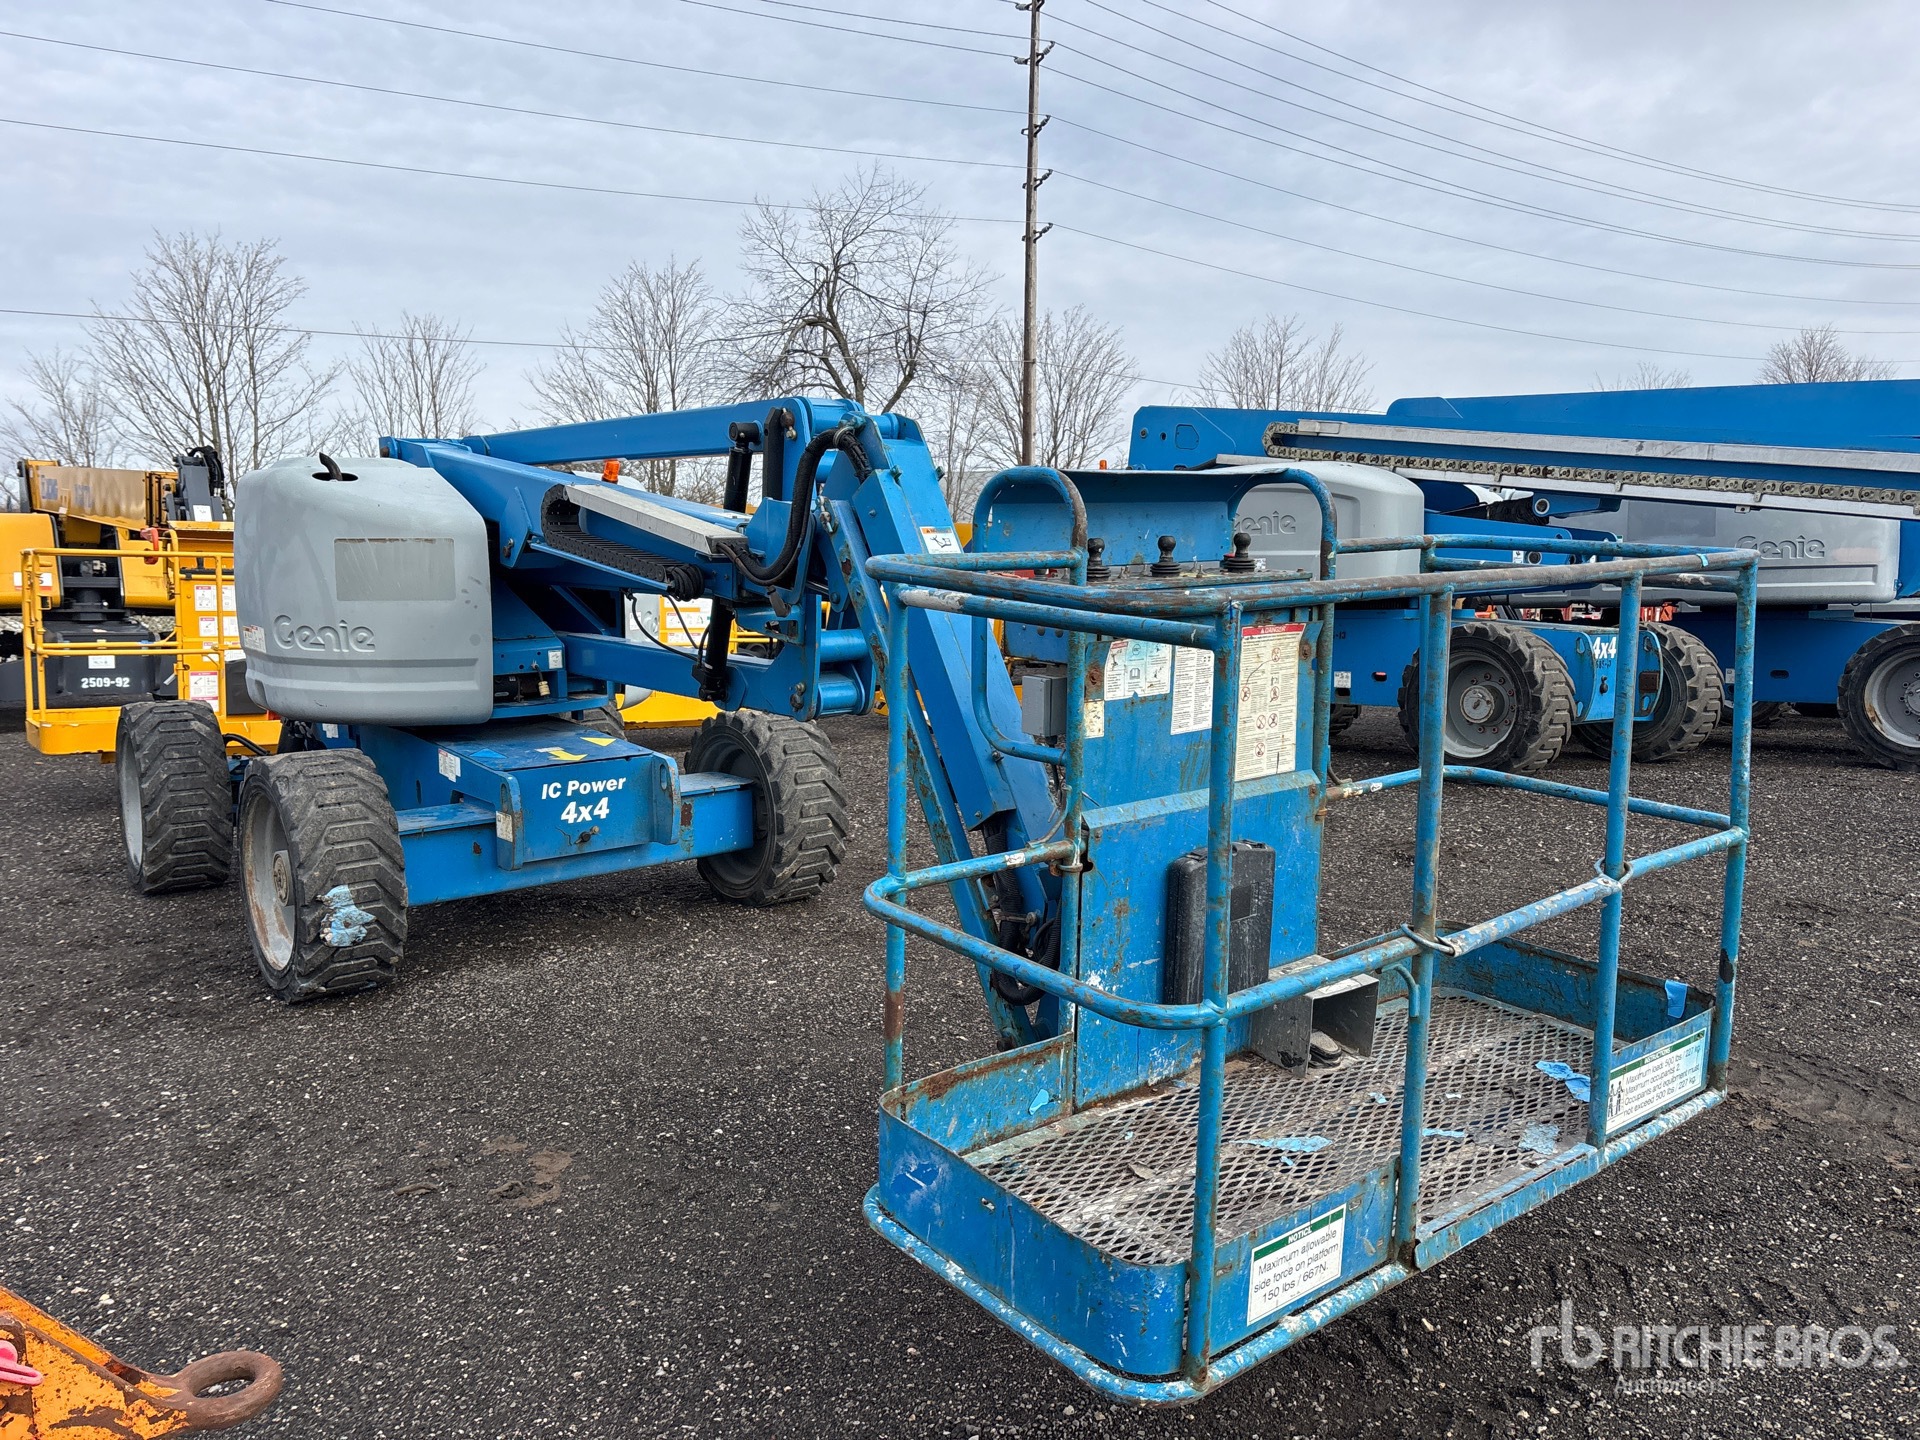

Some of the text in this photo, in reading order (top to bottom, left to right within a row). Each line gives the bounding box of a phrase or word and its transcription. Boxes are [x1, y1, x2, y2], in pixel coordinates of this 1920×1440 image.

[1234, 510, 1296, 536] enie
[1735, 534, 1826, 560] Genie
[273, 614, 376, 653] Genie
[1593, 636, 1617, 660] 4x4
[81, 677, 130, 689] 2509-92
[541, 776, 627, 800] IC Power
[560, 797, 610, 824] 4x4
[1625, 1079, 1651, 1096] Maximum
[1626, 1069, 1652, 1085] Maximum
[1624, 1107, 1634, 1116] not
[1634, 1095, 1655, 1111] exceed
[1656, 1091, 1667, 1102] 500
[1667, 1086, 1675, 1096] lbs
[1678, 1080, 1689, 1090] 227
[1625, 1087, 1652, 1106] Occupants
[1652, 1083, 1663, 1094] and
[1258, 1229, 1337, 1276] Maximum allowable
[1254, 1243, 1339, 1293] side force on platform
[1263, 1287, 1280, 1303] 150
[1282, 1280, 1296, 1294] lbs
[1302, 1261, 1329, 1282] 667N.
